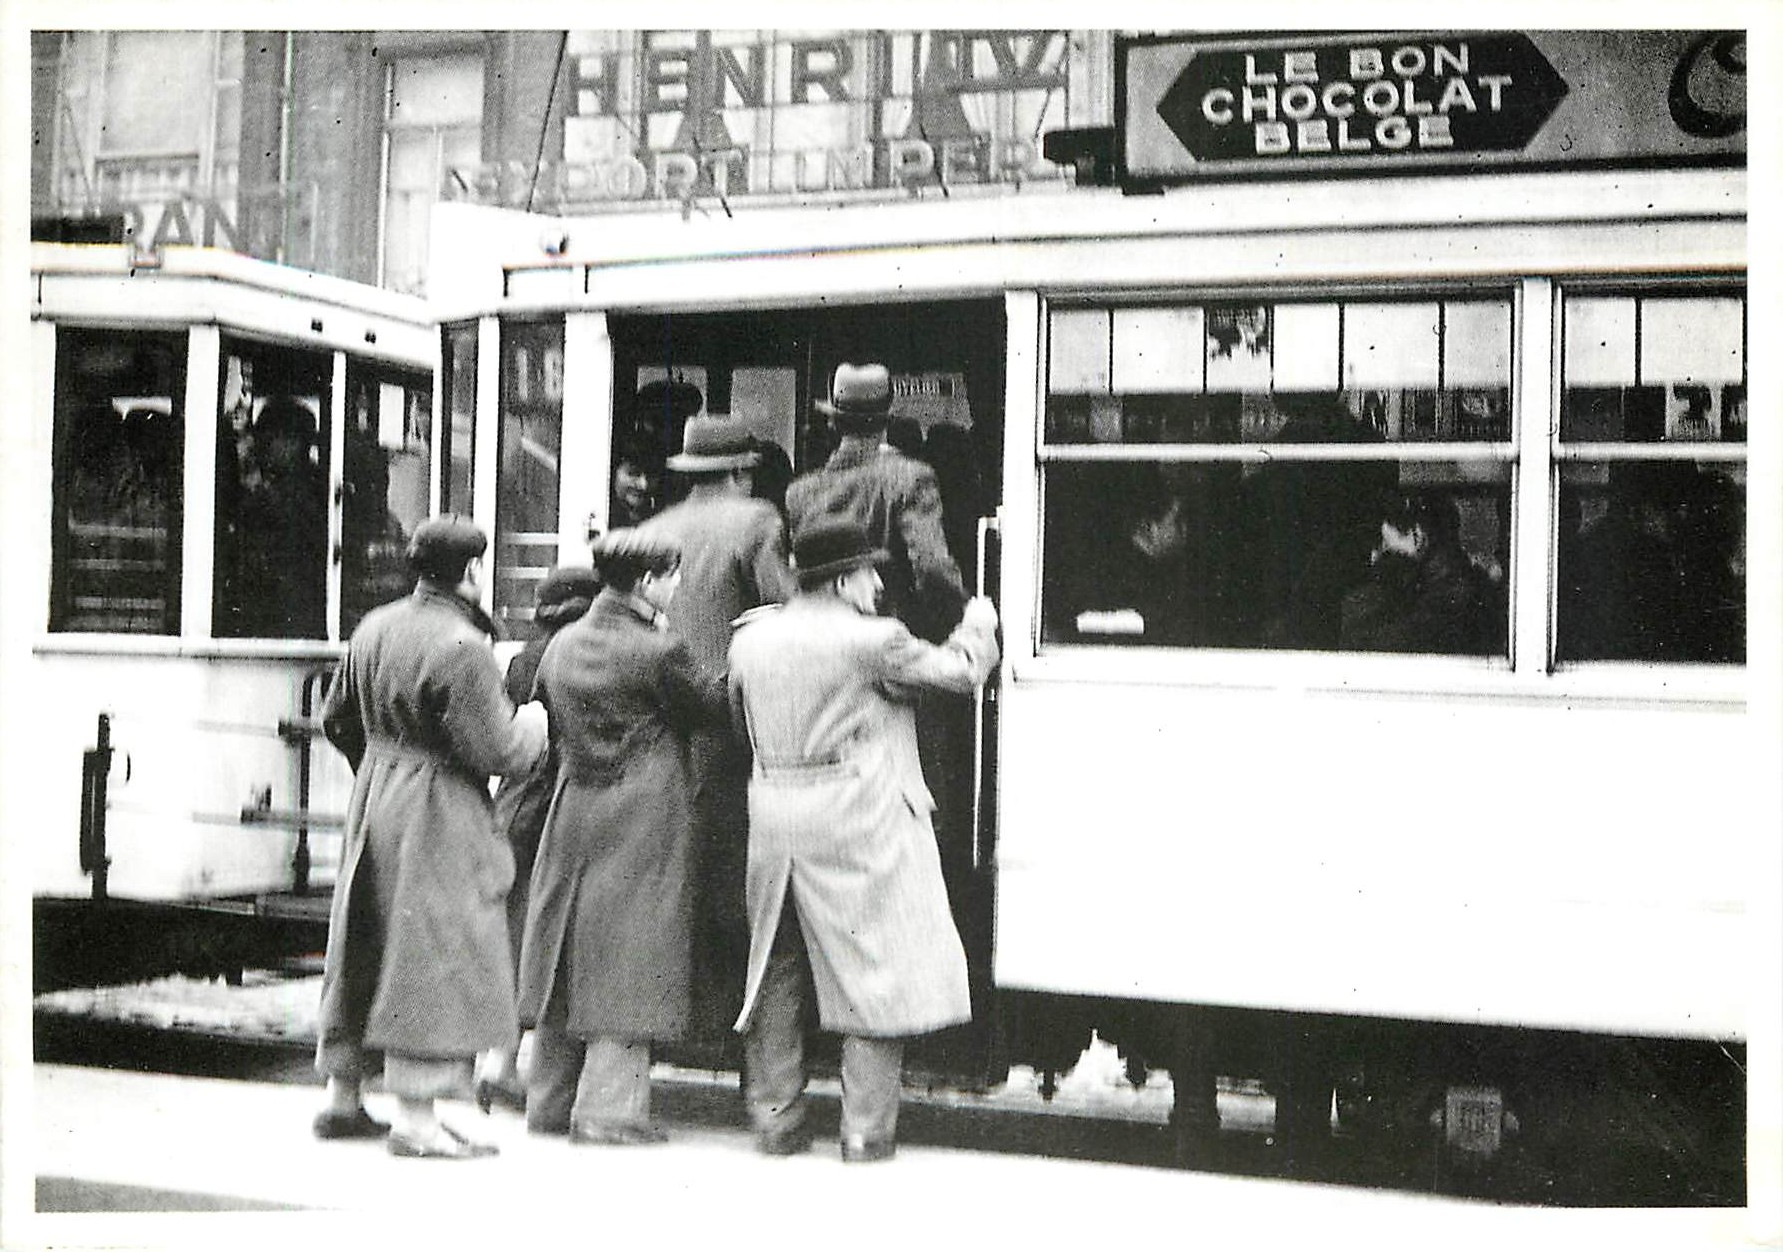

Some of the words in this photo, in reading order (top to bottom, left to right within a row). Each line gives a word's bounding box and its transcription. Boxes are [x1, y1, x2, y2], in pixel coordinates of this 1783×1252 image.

[566, 34, 893, 115] HENRI
[1247, 52, 1319, 85] LE
[1350, 43, 1468, 80] BON
[1202, 75, 1512, 125] CHOCOLAT
[1255, 115, 1454, 154] BELGE
